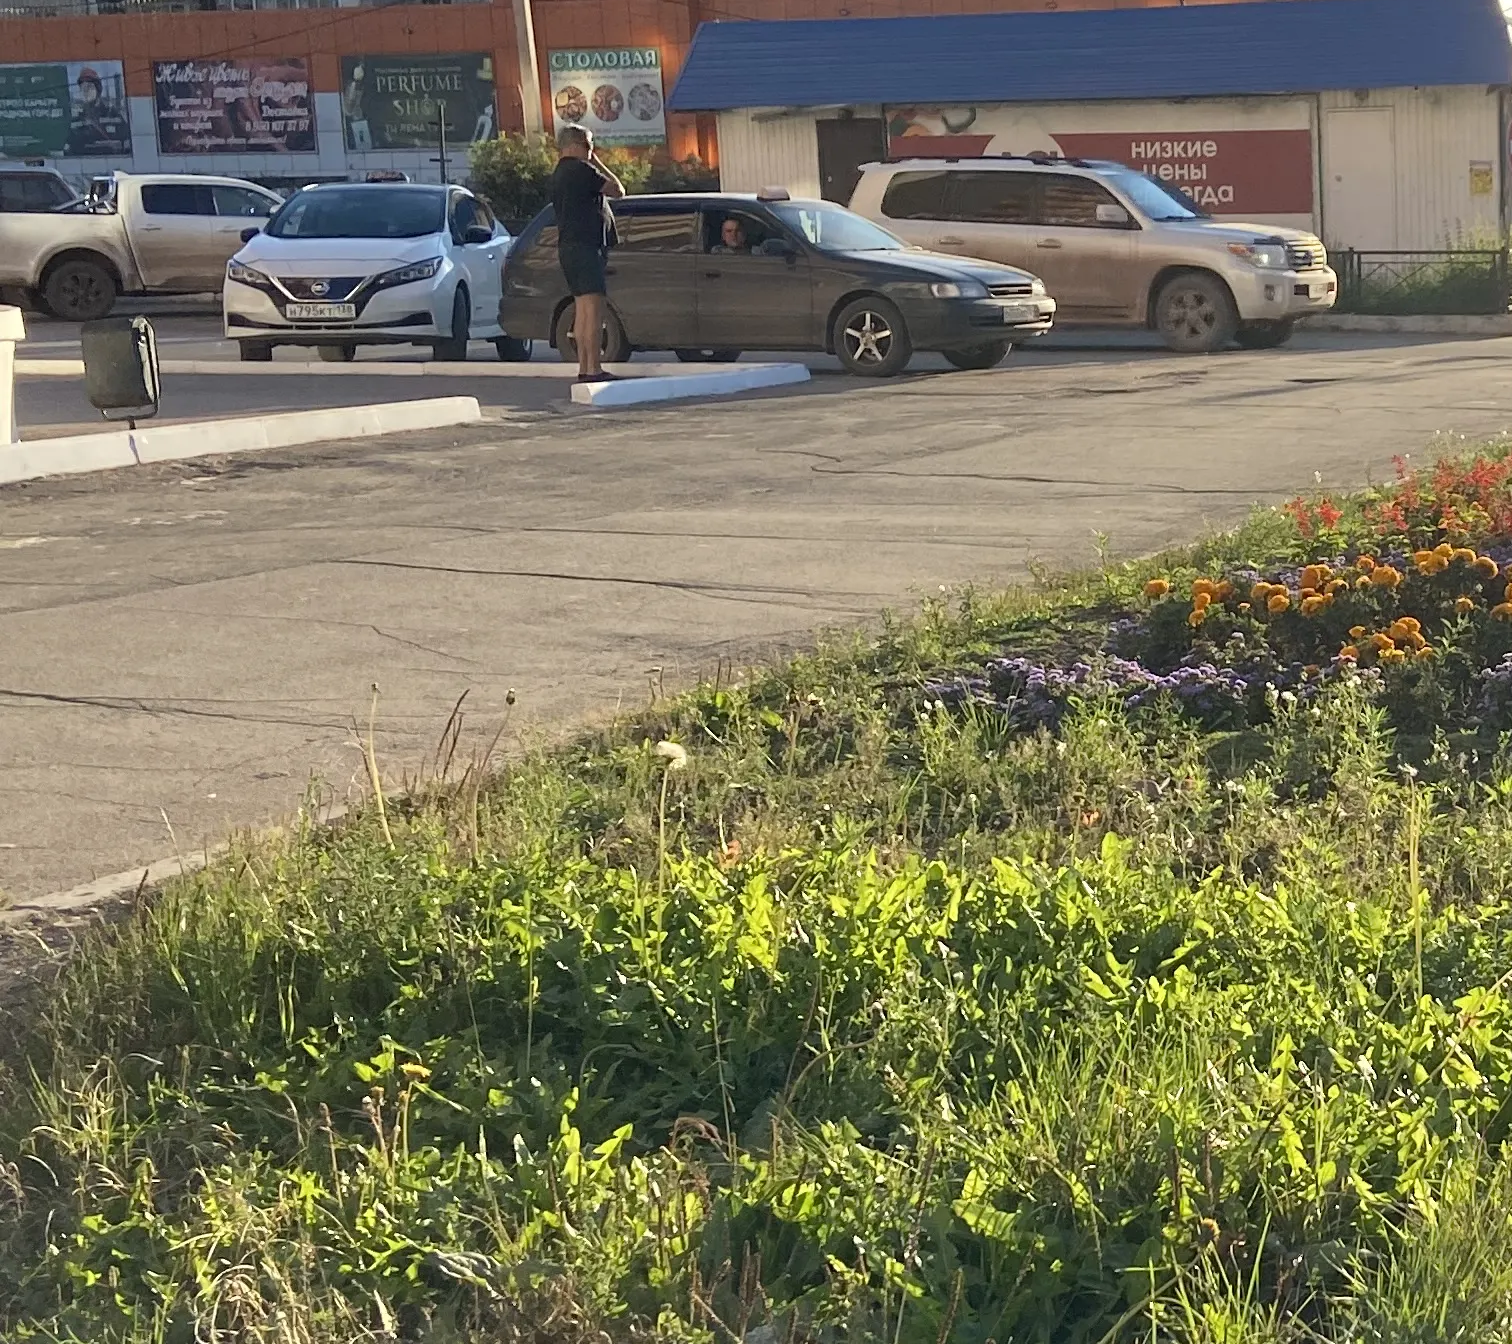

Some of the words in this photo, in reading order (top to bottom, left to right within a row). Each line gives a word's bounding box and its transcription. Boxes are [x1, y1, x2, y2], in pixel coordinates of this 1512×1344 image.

[551, 49, 658, 68] СТОЛОВАЯ
[376, 74, 463, 95] PERFUME
[1130, 139, 1218, 159] низкие
[1143, 163, 1207, 181] цены
[1180, 184, 1235, 205] егда
